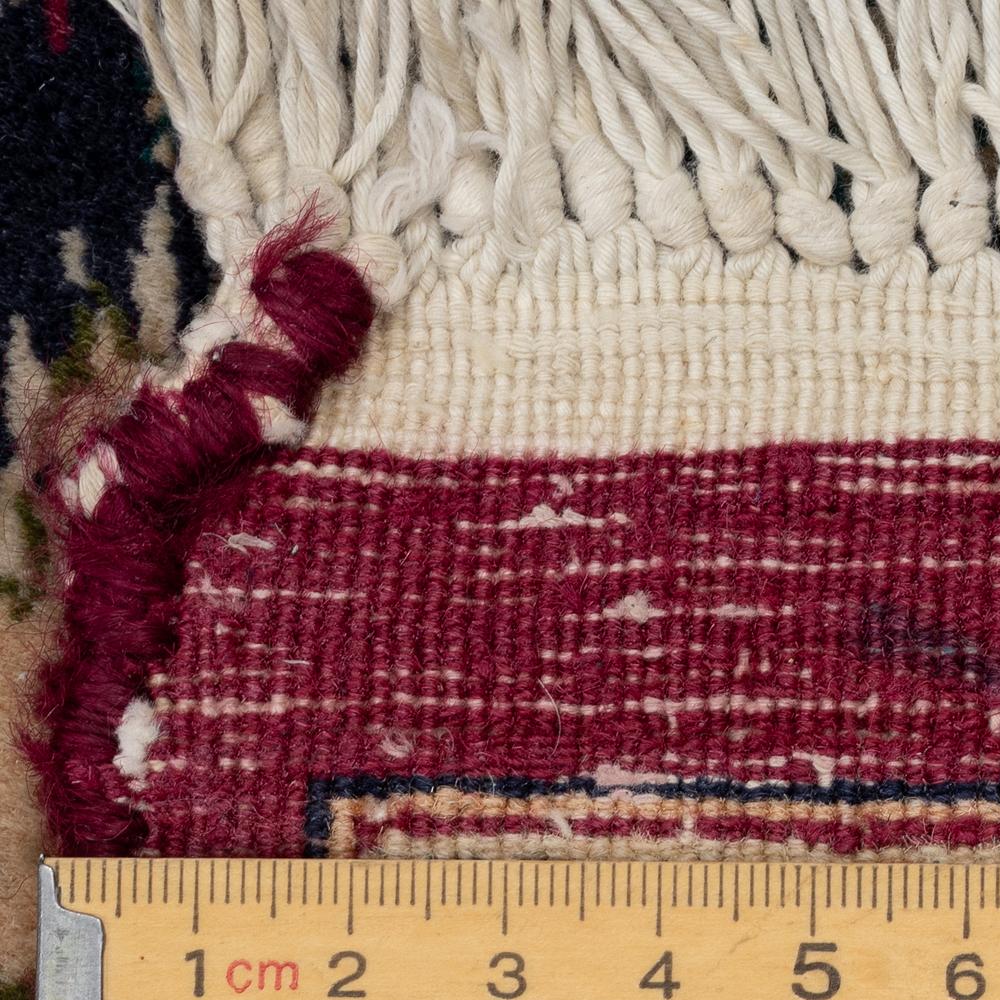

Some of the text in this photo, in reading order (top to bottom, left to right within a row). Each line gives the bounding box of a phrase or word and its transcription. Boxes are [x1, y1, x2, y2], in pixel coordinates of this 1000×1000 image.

[184, 948, 205, 998] 1
[225, 958, 300, 993] cm
[327, 950, 367, 999] 2
[486, 951, 528, 1000] 3
[638, 950, 681, 1000] 4
